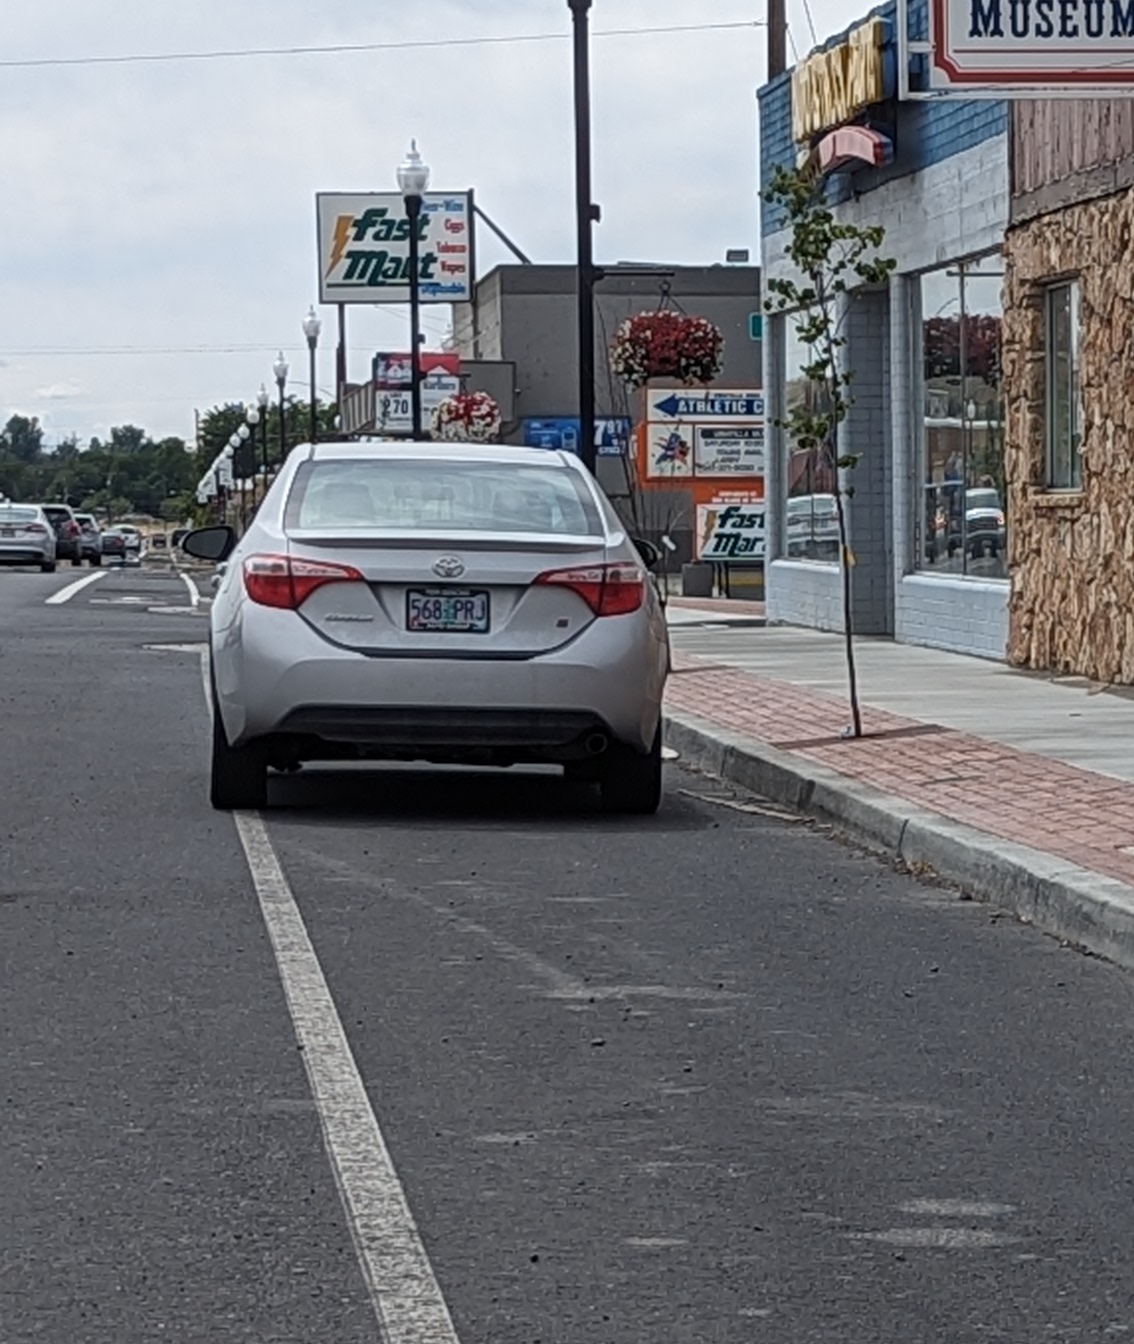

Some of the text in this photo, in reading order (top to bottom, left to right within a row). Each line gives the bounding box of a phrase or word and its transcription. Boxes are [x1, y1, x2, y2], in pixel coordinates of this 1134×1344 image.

[678, 400, 748, 414] ATHLETIC
[712, 532, 766, 557] Mar
[411, 599, 486, 621] 568 PRJ
